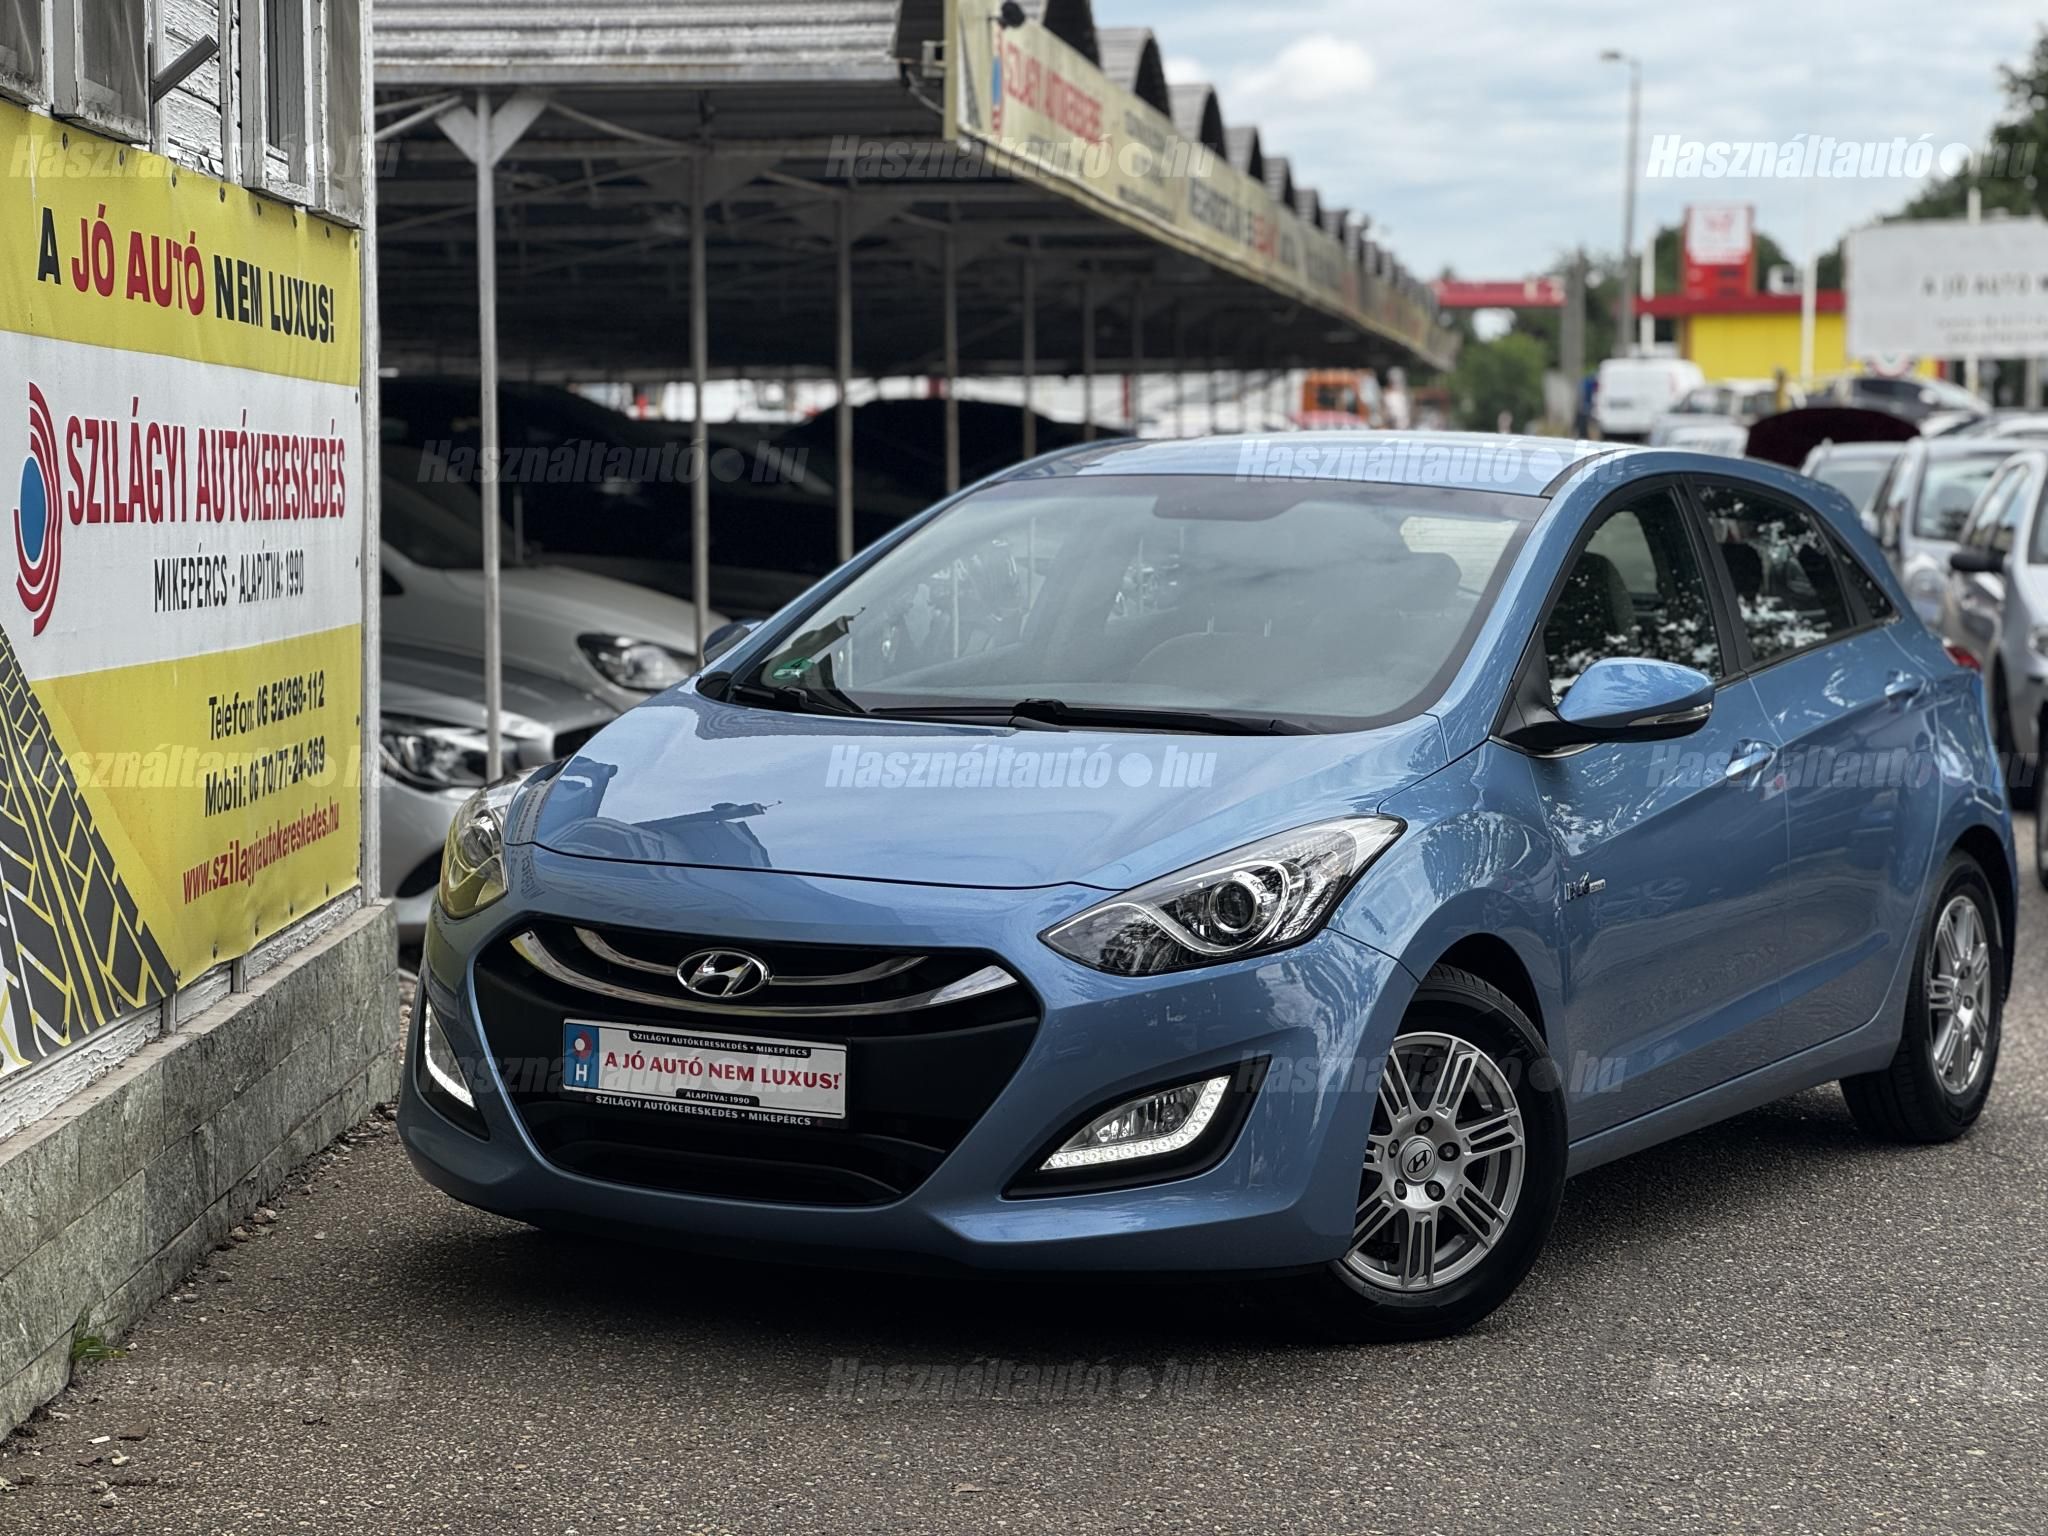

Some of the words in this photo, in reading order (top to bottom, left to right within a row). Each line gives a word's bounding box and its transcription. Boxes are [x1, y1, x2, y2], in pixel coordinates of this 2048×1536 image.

[37, 206, 62, 286] A
[71, 203, 115, 298] JÓ
[126, 231, 206, 316] AUTÓ
[213, 253, 264, 328] NEM
[268, 270, 335, 344] LUXUS!
[66, 396, 188, 526] SZILÁGYI
[196, 408, 346, 524] AUTÓKERESKEDÉS
[153, 542, 228, 614] MIKEPÉRCS
[239, 538, 284, 604] ALAPÍTVA:
[285, 549, 304, 600] 1990
[208, 692, 255, 741] Telefon:
[257, 684, 269, 727] 06
[205, 765, 247, 818] Mobil:
[250, 759, 260, 803] 06
[183, 796, 339, 904] www.szilagyiautokereskedes.hu
[604, 1051, 618, 1067] A
[623, 1050, 645, 1071] JÓ
[649, 1056, 703, 1077] AUTÓ
[709, 1064, 755, 1082] NEM
[761, 1067, 840, 1090] LUXUS!
[632, 1031, 670, 1044] SZILÁGYI
[671, 1036, 749, 1051] AUTÓKERESKEDÉS
[756, 1045, 808, 1056] MIKEPÉRCS
[575, 1063, 588, 1082] H
[685, 1091, 729, 1103] ALAPÍTVA:
[730, 1095, 750, 1105] 1990
[595, 1095, 642, 1109] SZILÁGYI
[644, 1099, 739, 1119] AUTÓKERESKEDÉS
[748, 1112, 812, 1126] MIKEPÉRCS
